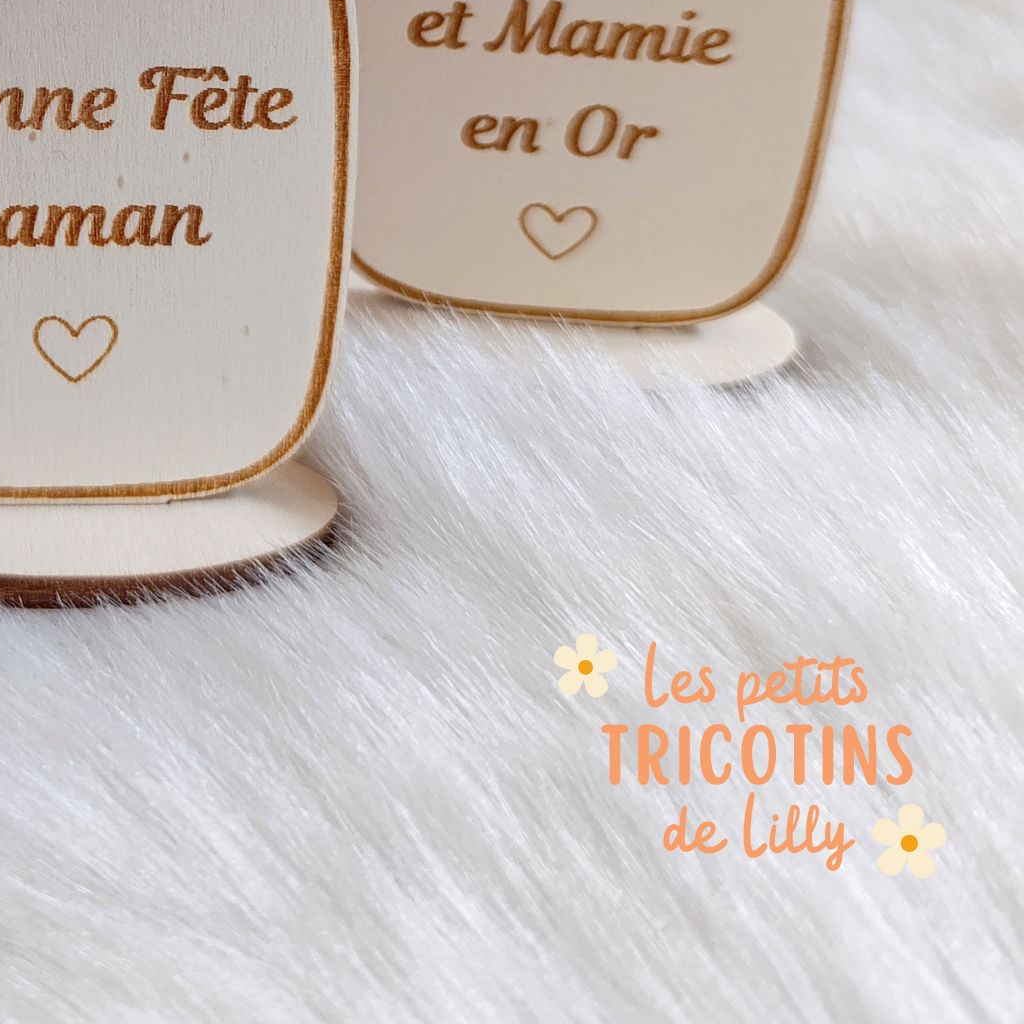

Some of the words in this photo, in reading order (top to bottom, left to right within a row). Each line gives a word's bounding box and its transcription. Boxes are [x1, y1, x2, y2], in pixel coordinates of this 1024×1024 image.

[407, 1, 474, 50] et
[138, 65, 299, 131] Fête
[460, 113, 540, 154] en
[564, 103, 659, 160] Or
